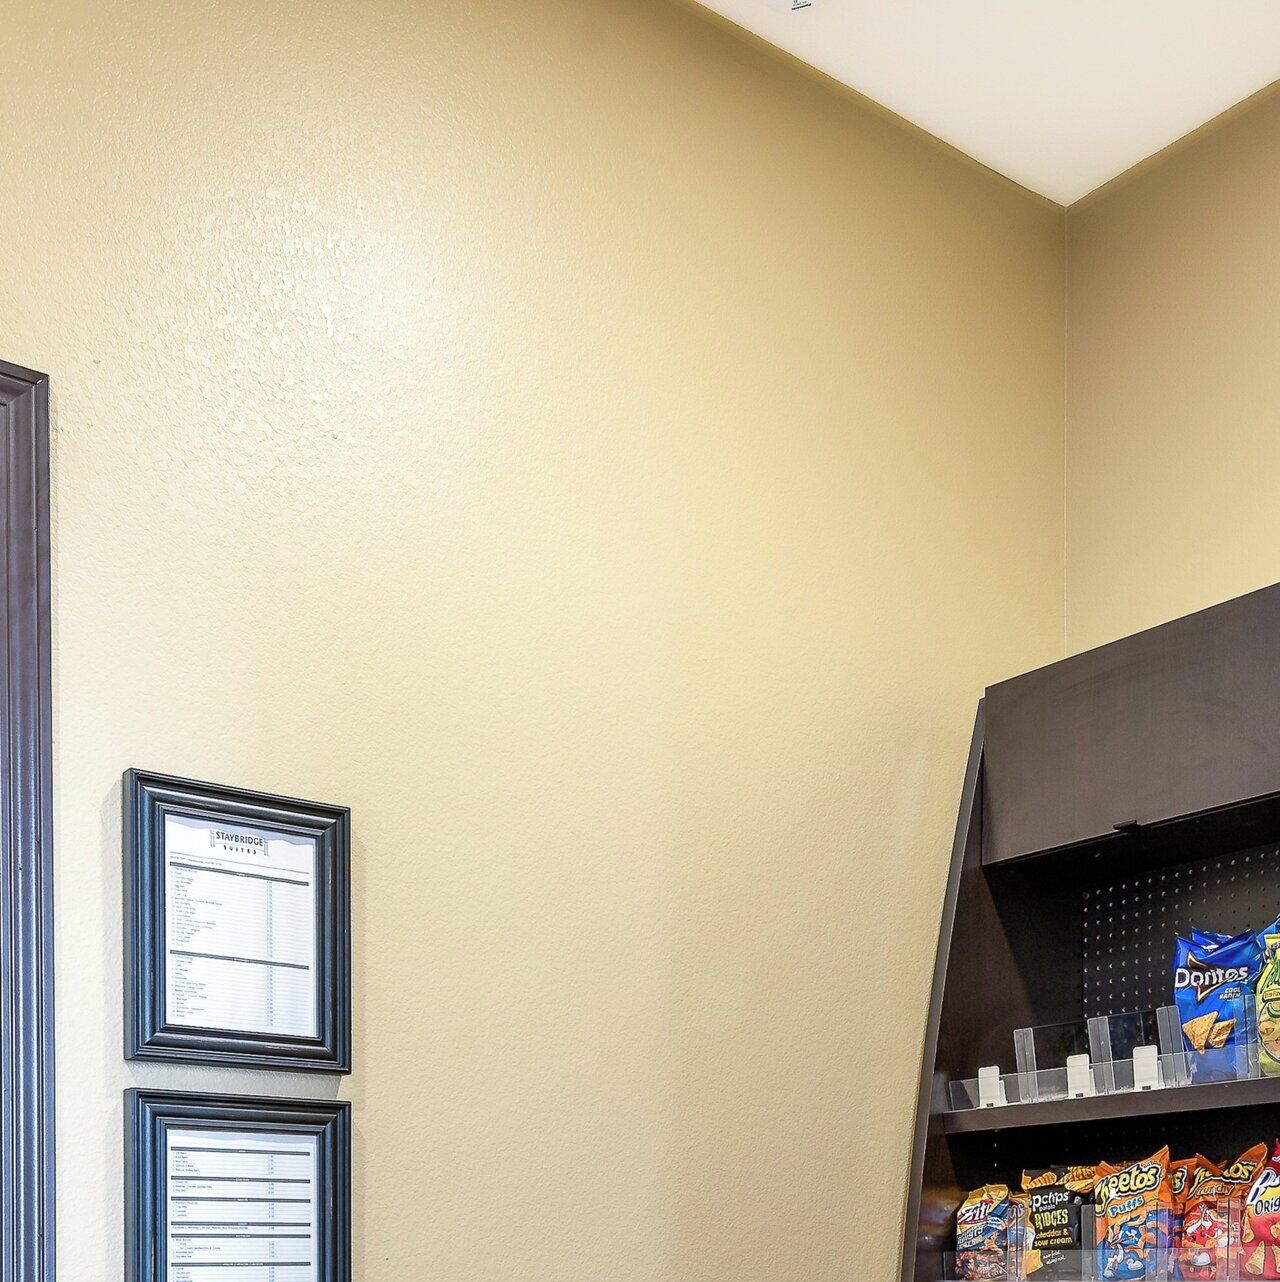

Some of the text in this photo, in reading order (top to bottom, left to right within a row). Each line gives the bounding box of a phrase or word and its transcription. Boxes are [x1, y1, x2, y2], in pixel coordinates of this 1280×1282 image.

[216, 831, 263, 847] STAYBRIDGE
[224, 845, 257, 855] SUITES
[1174, 966, 1249, 988] Doritos
[1094, 1162, 1162, 1216] Cheetos
[1108, 1196, 1145, 1217] Puffs
[1034, 1209, 1069, 1230] RIDGES
[1034, 1236, 1072, 1246] sour cream
[1036, 1230, 1062, 1240] cheddar
